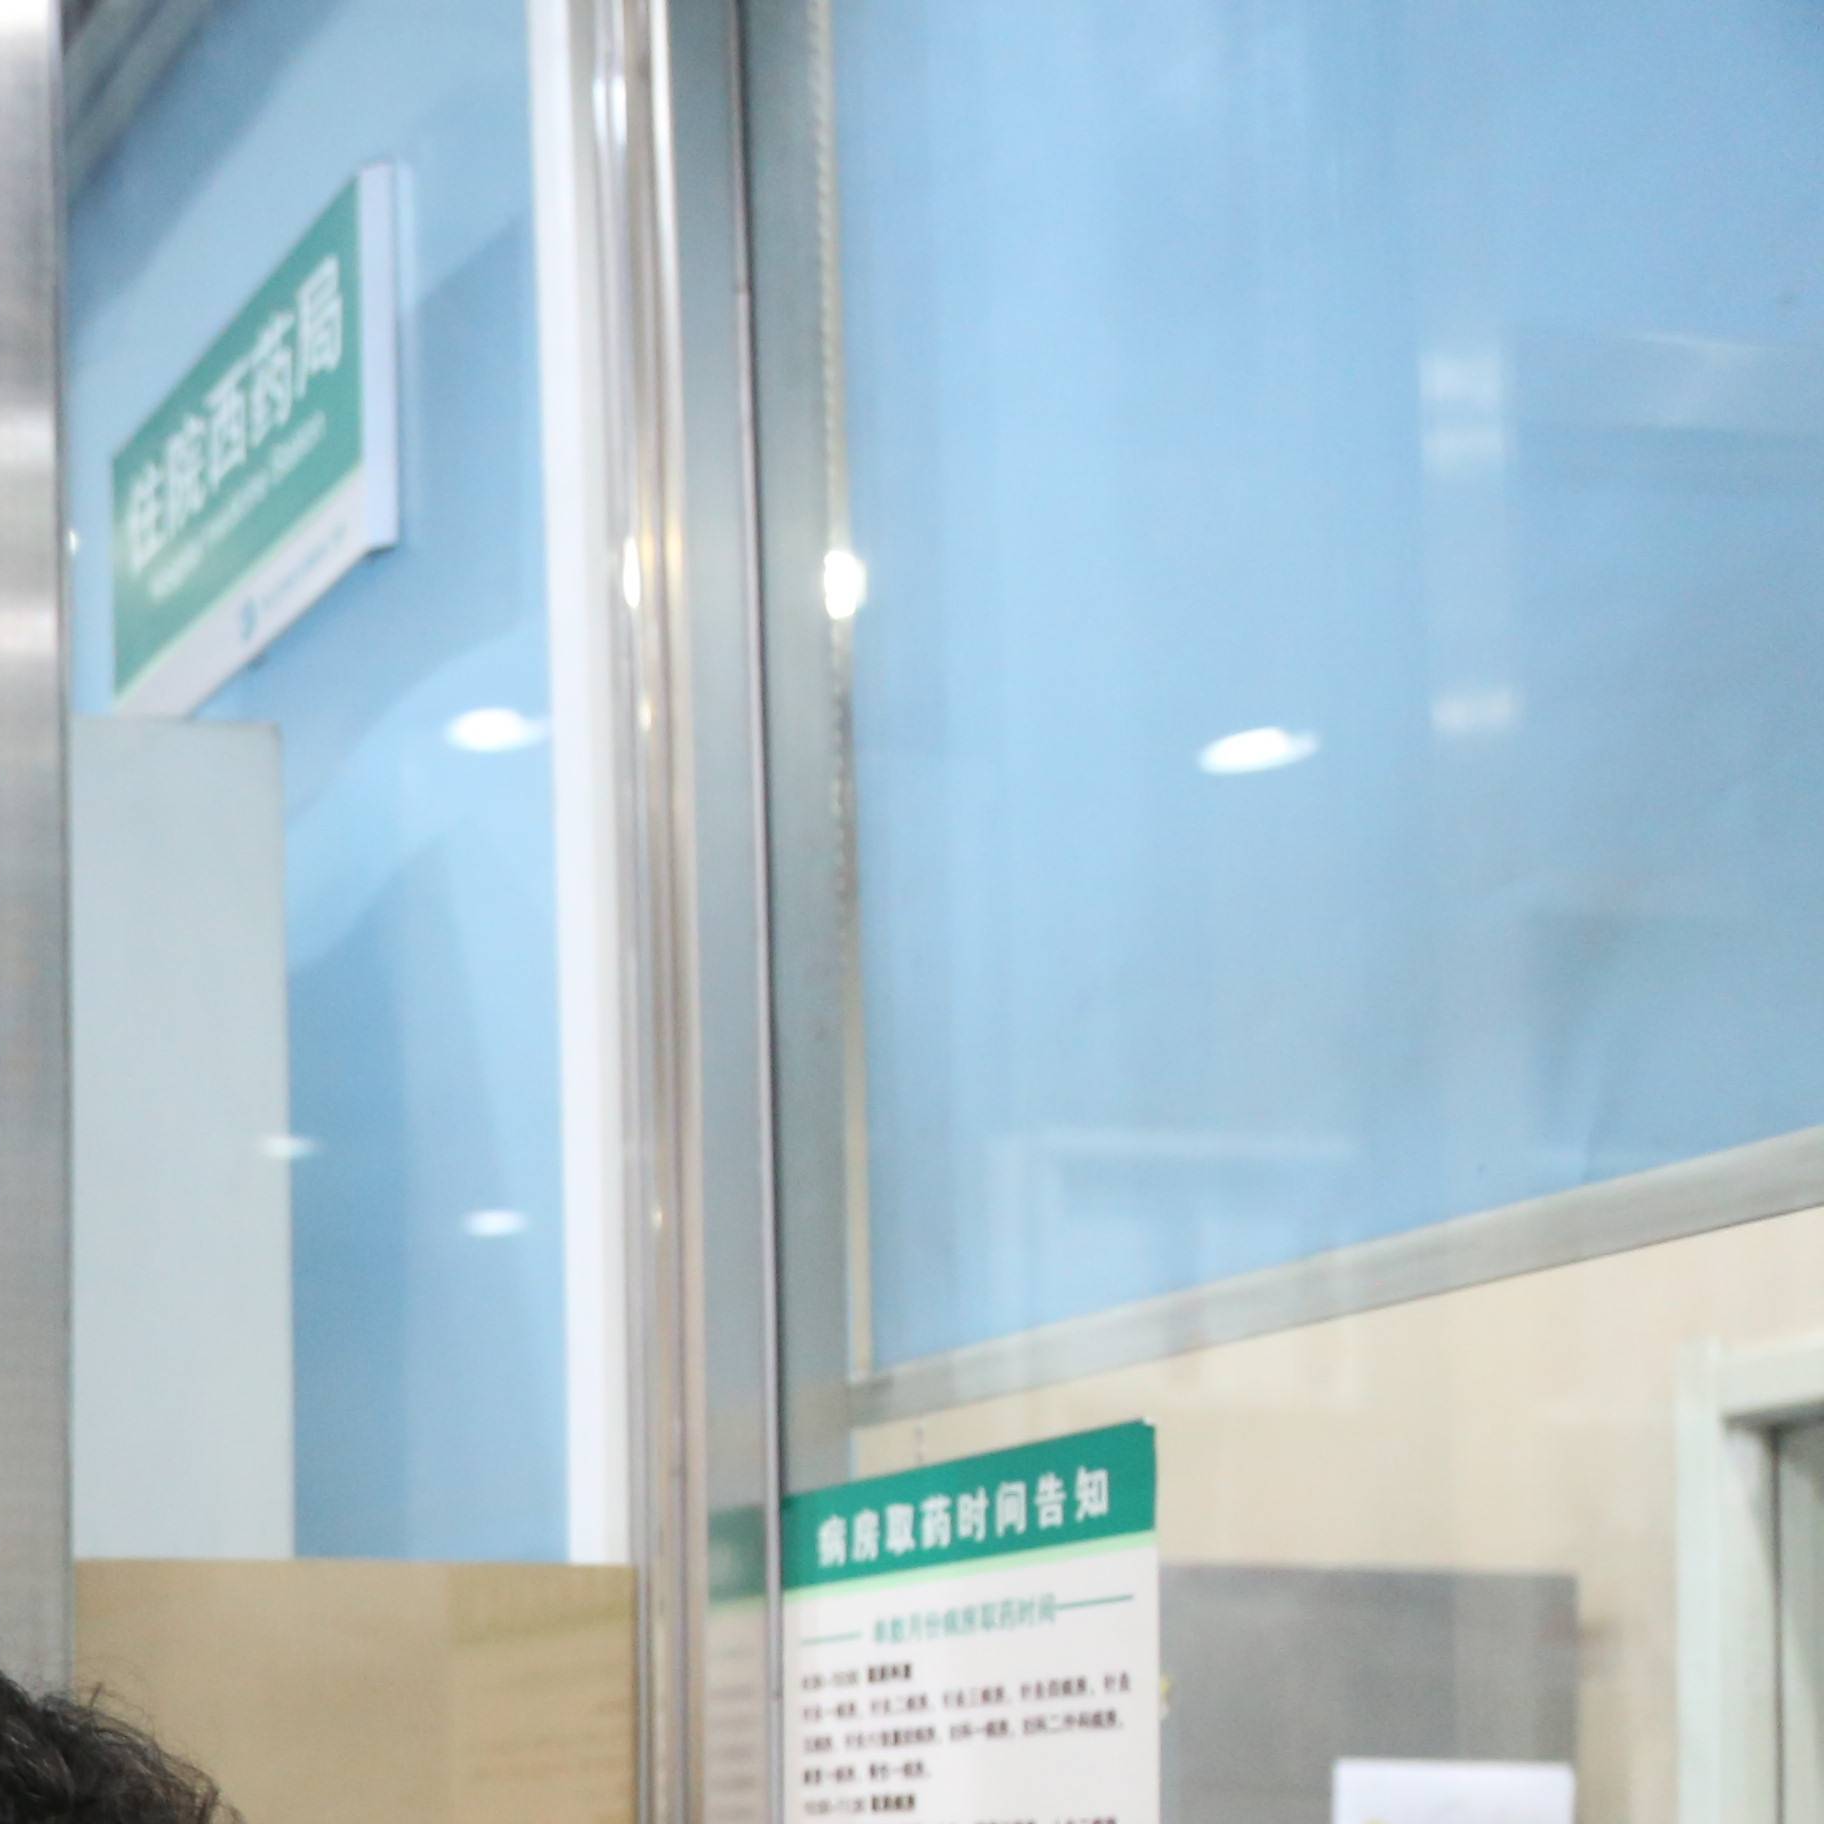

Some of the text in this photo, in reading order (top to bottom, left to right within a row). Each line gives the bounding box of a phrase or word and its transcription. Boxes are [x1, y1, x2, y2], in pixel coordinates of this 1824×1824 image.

[818, 1466, 1109, 1568] 病房取药时间告知
